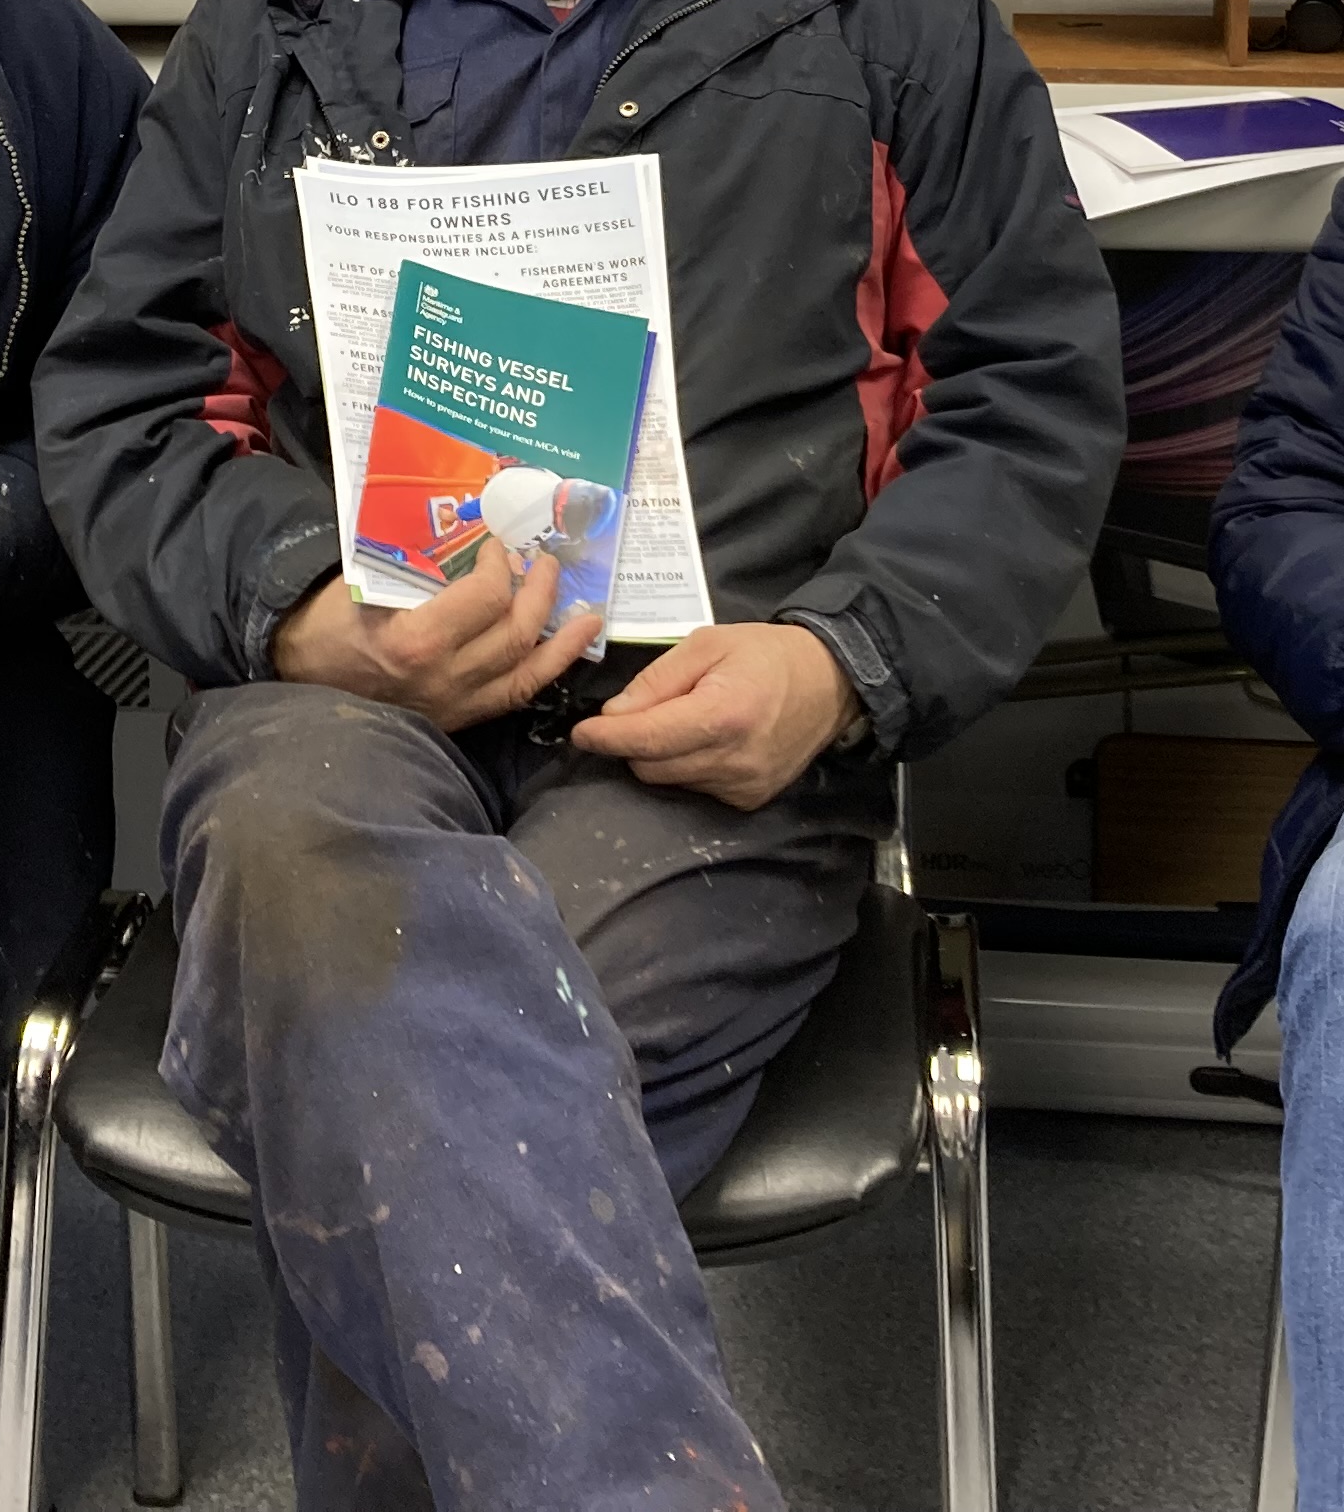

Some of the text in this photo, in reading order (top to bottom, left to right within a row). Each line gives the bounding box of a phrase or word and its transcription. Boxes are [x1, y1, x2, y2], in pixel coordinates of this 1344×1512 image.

[330, 181, 610, 210] ILO 188 FOR FISHING VESSEL
[326, 218, 636, 244] YOUR RESPONSBILITIES AS A FISHING VESSEL
[430, 212, 512, 230] OWNERS
[422, 244, 538, 258] OWNER INCLUDE:
[339, 262, 386, 276] LIST OF
[520, 256, 646, 278] FISHERMEN'S WORK
[542, 272, 628, 289] AGREEMENTS
[340, 303, 369, 316] RISK
[414, 324, 492, 368] FISHING
[497, 356, 574, 392] VESSEL
[410, 346, 546, 407] SURVEYS AND
[407, 364, 537, 428] INSPECTIONS
[403, 387, 580, 460] How to prepare for your next MCA visit
